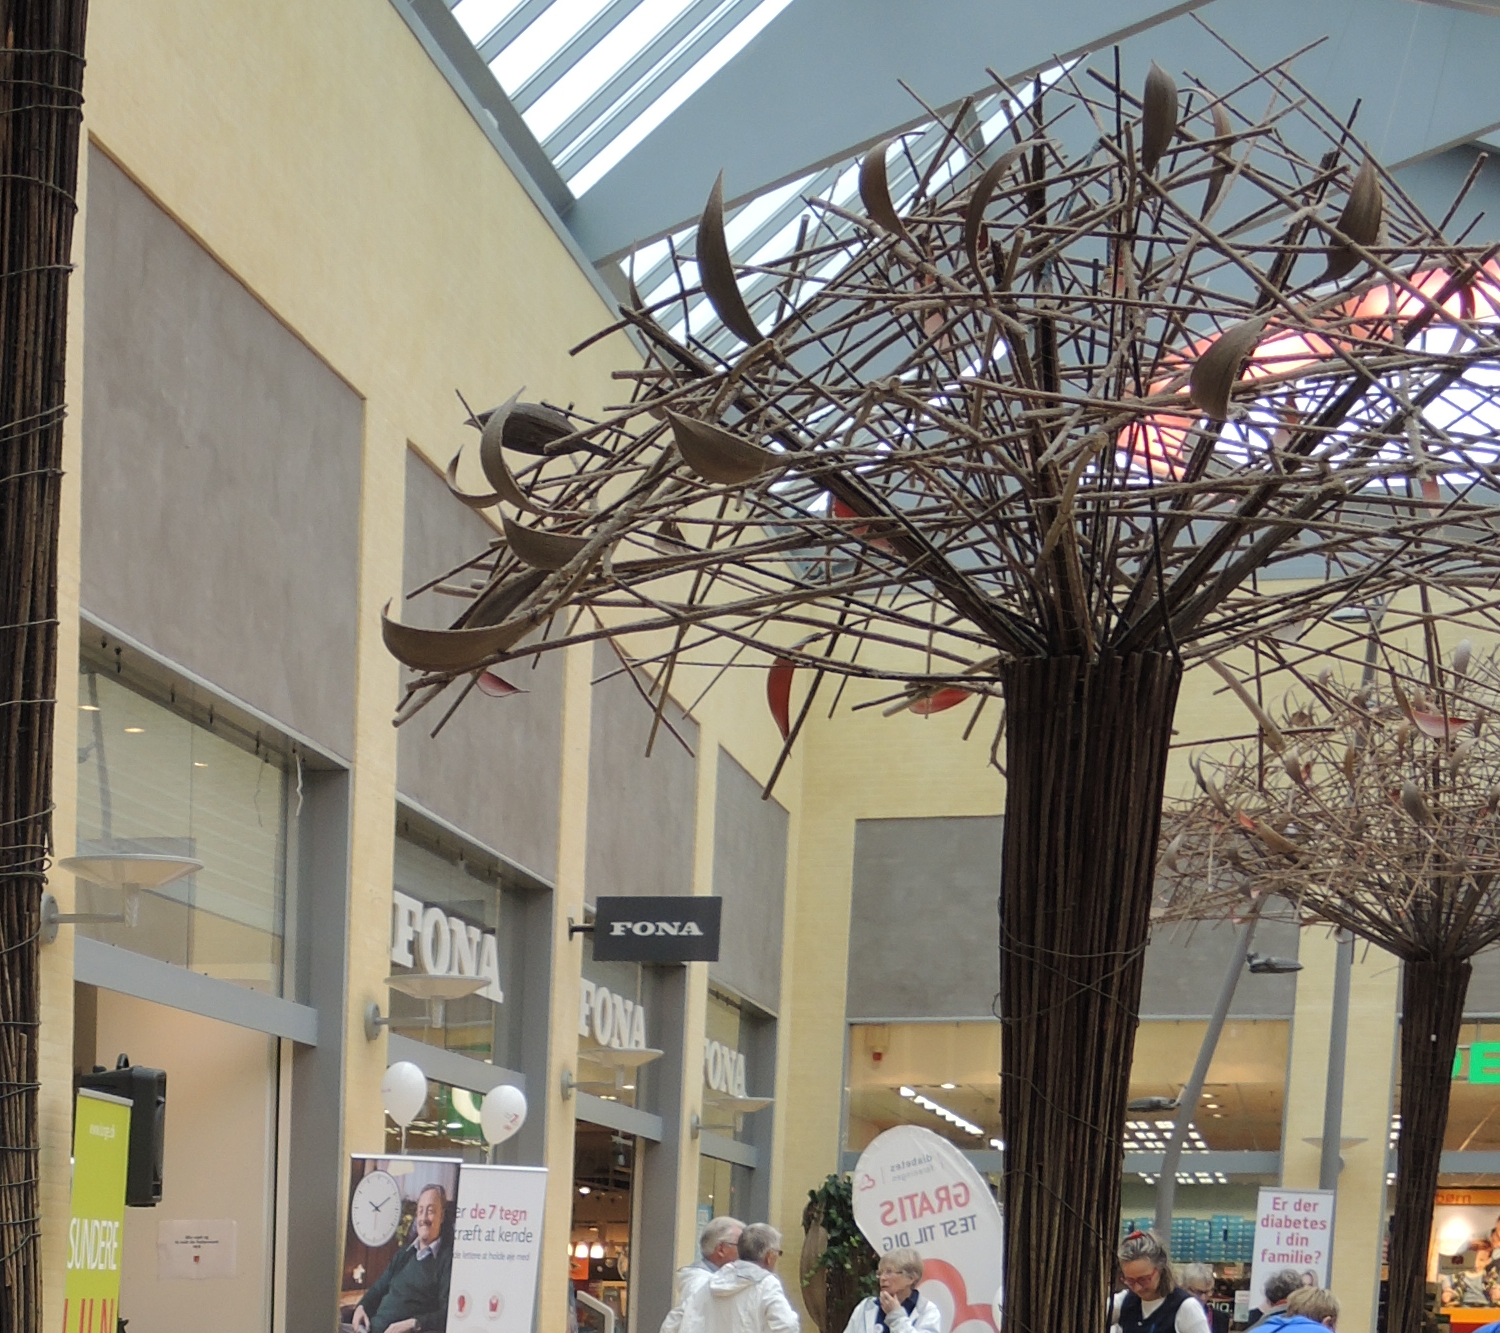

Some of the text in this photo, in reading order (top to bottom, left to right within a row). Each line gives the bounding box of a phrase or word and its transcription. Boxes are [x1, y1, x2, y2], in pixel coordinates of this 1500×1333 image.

[610, 921, 704, 936] FONA
[392, 890, 503, 1003] FONA
[579, 977, 645, 1049] FONA
[1272, 1197, 1319, 1212] Er der
[470, 1203, 486, 1219] de
[488, 1204, 497, 1219] 7
[499, 1206, 527, 1226] tegn
[1261, 1214, 1327, 1230] diabetes
[485, 1228, 495, 1242] at
[498, 1226, 533, 1243] kende
[1276, 1232, 1309, 1246] i din
[67, 1218, 119, 1270] SUNDERE
[1261, 1249, 1322, 1264] familie?
